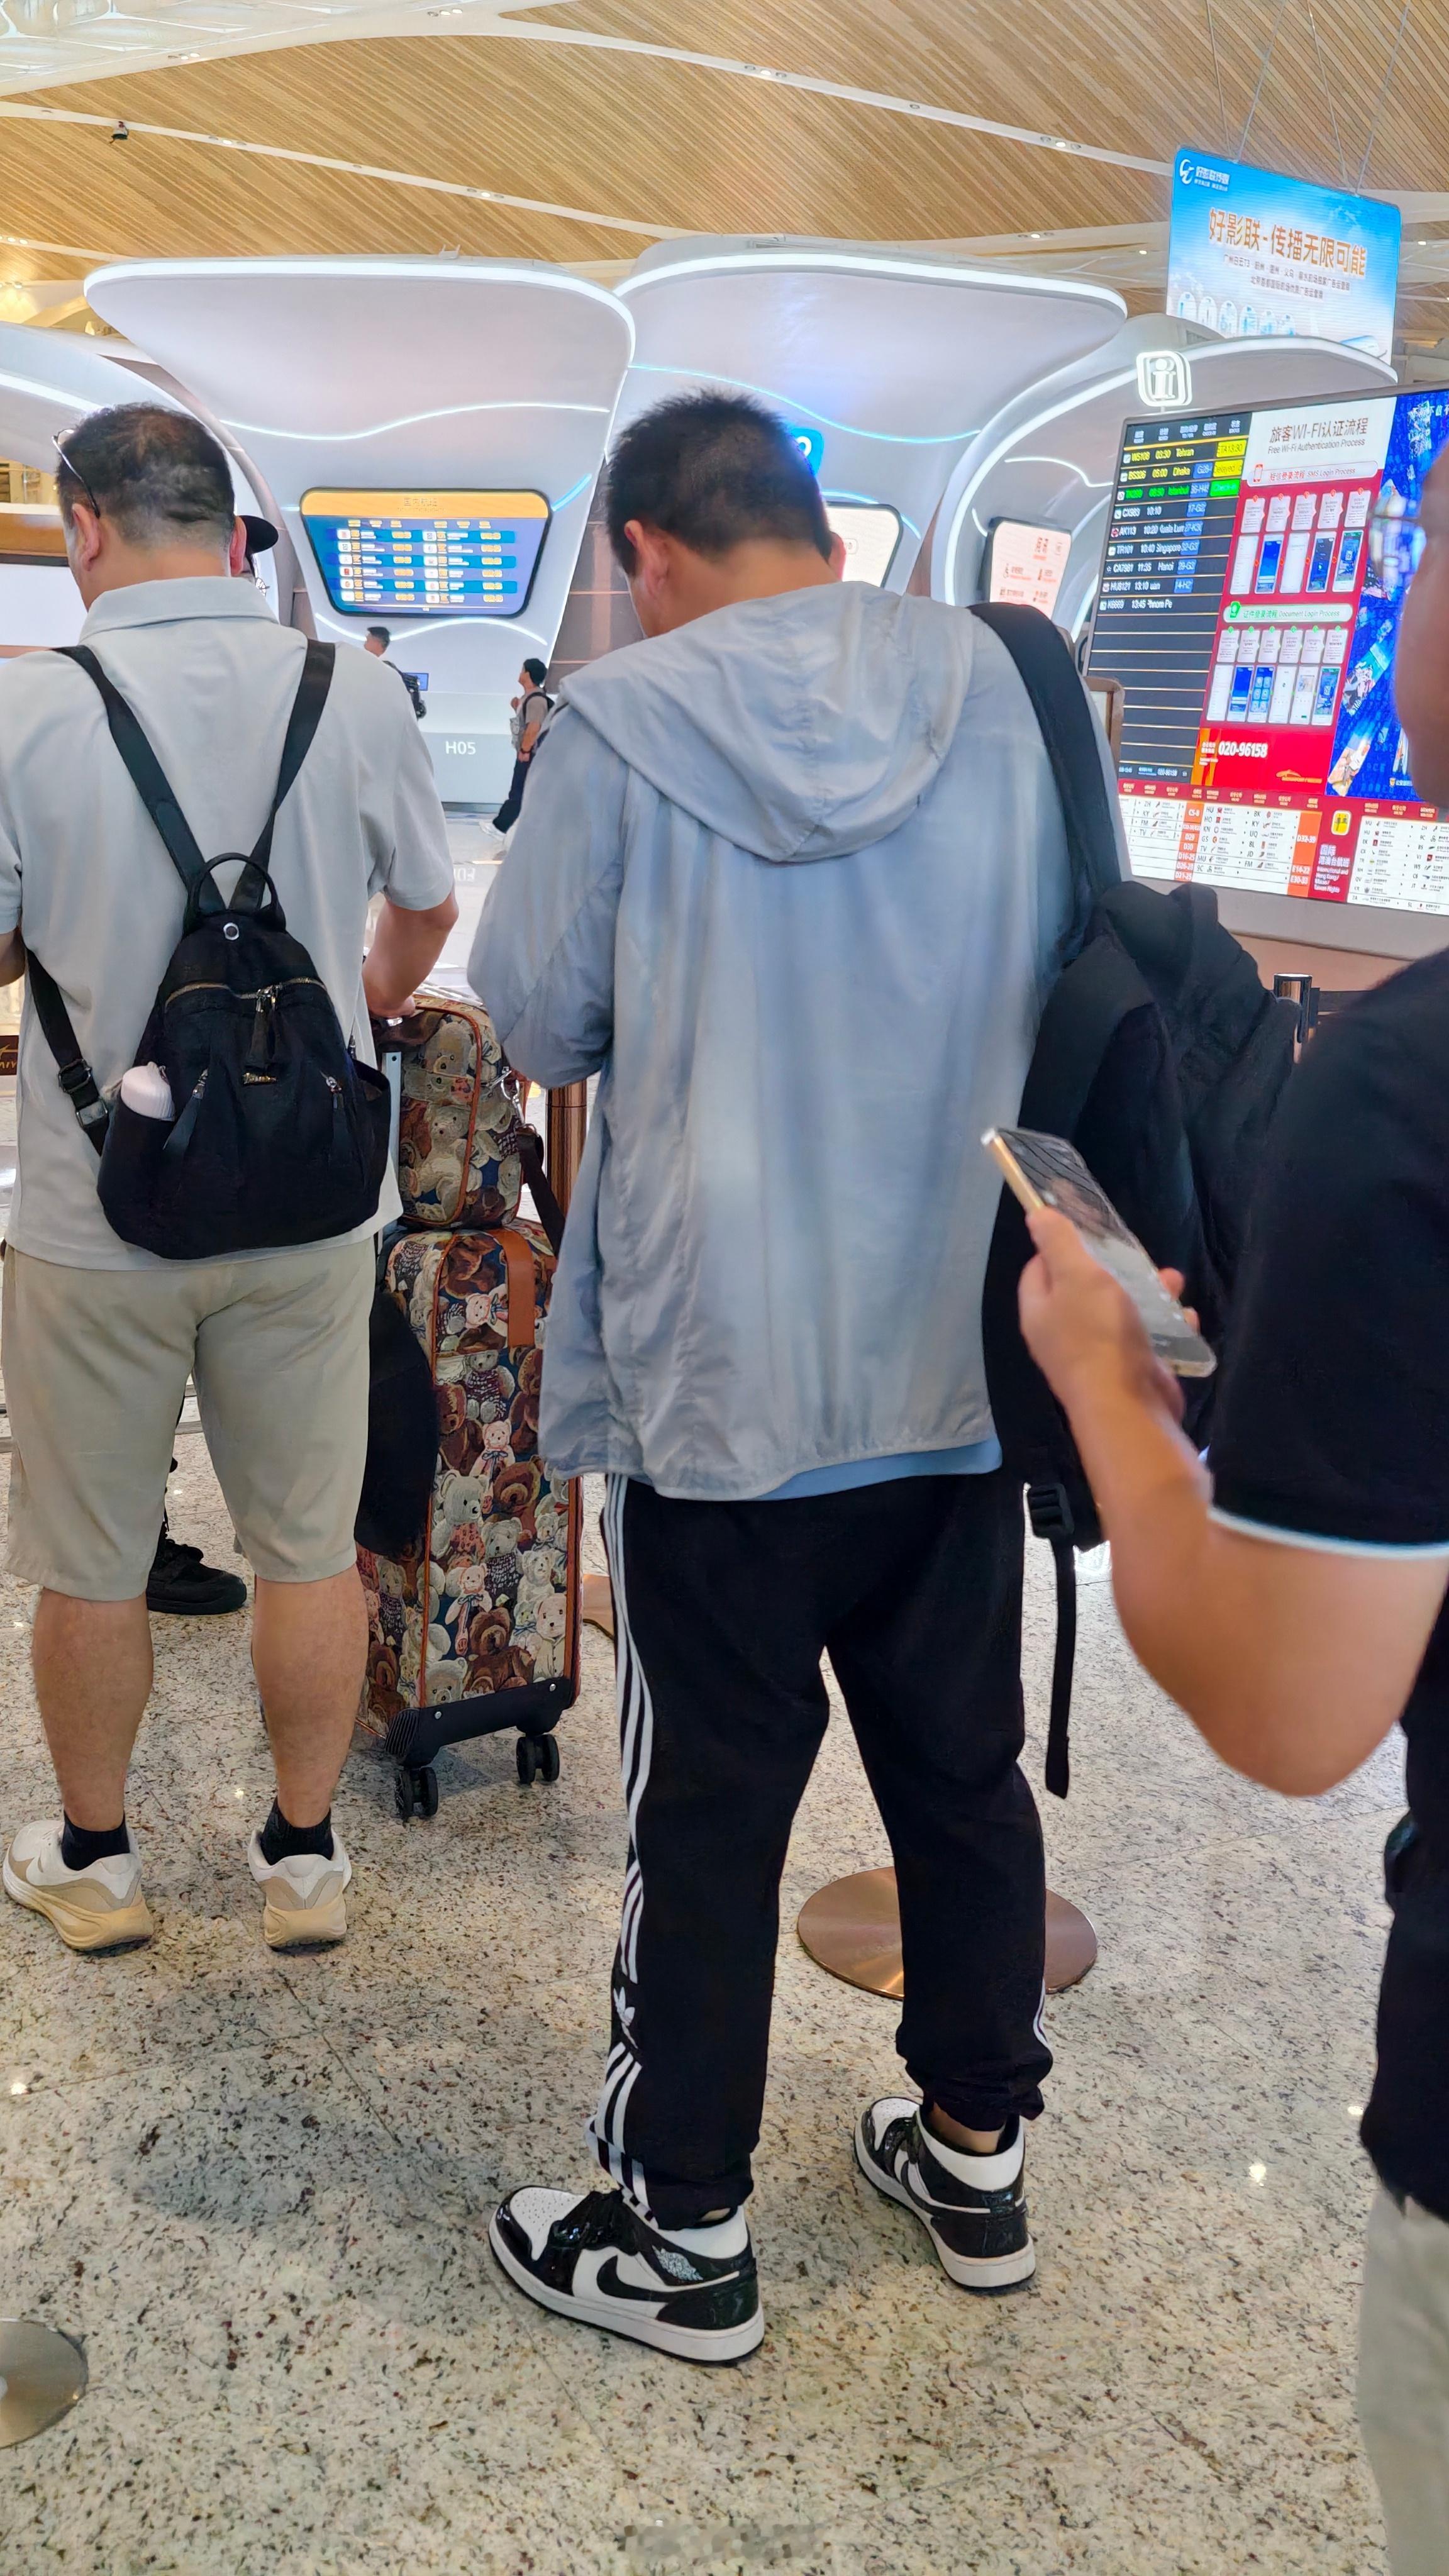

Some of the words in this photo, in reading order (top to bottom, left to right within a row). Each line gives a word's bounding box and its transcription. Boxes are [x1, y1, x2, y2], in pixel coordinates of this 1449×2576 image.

[1270, 418, 1368, 443] 旅客WI-FI认证流程
[1268, 445, 1280, 454] Free
[1297, 440, 1340, 452] Authentication
[1340, 438, 1365, 448] Process
[445, 741, 476, 755] H05
[1218, 741, 1269, 758] 020-96158
